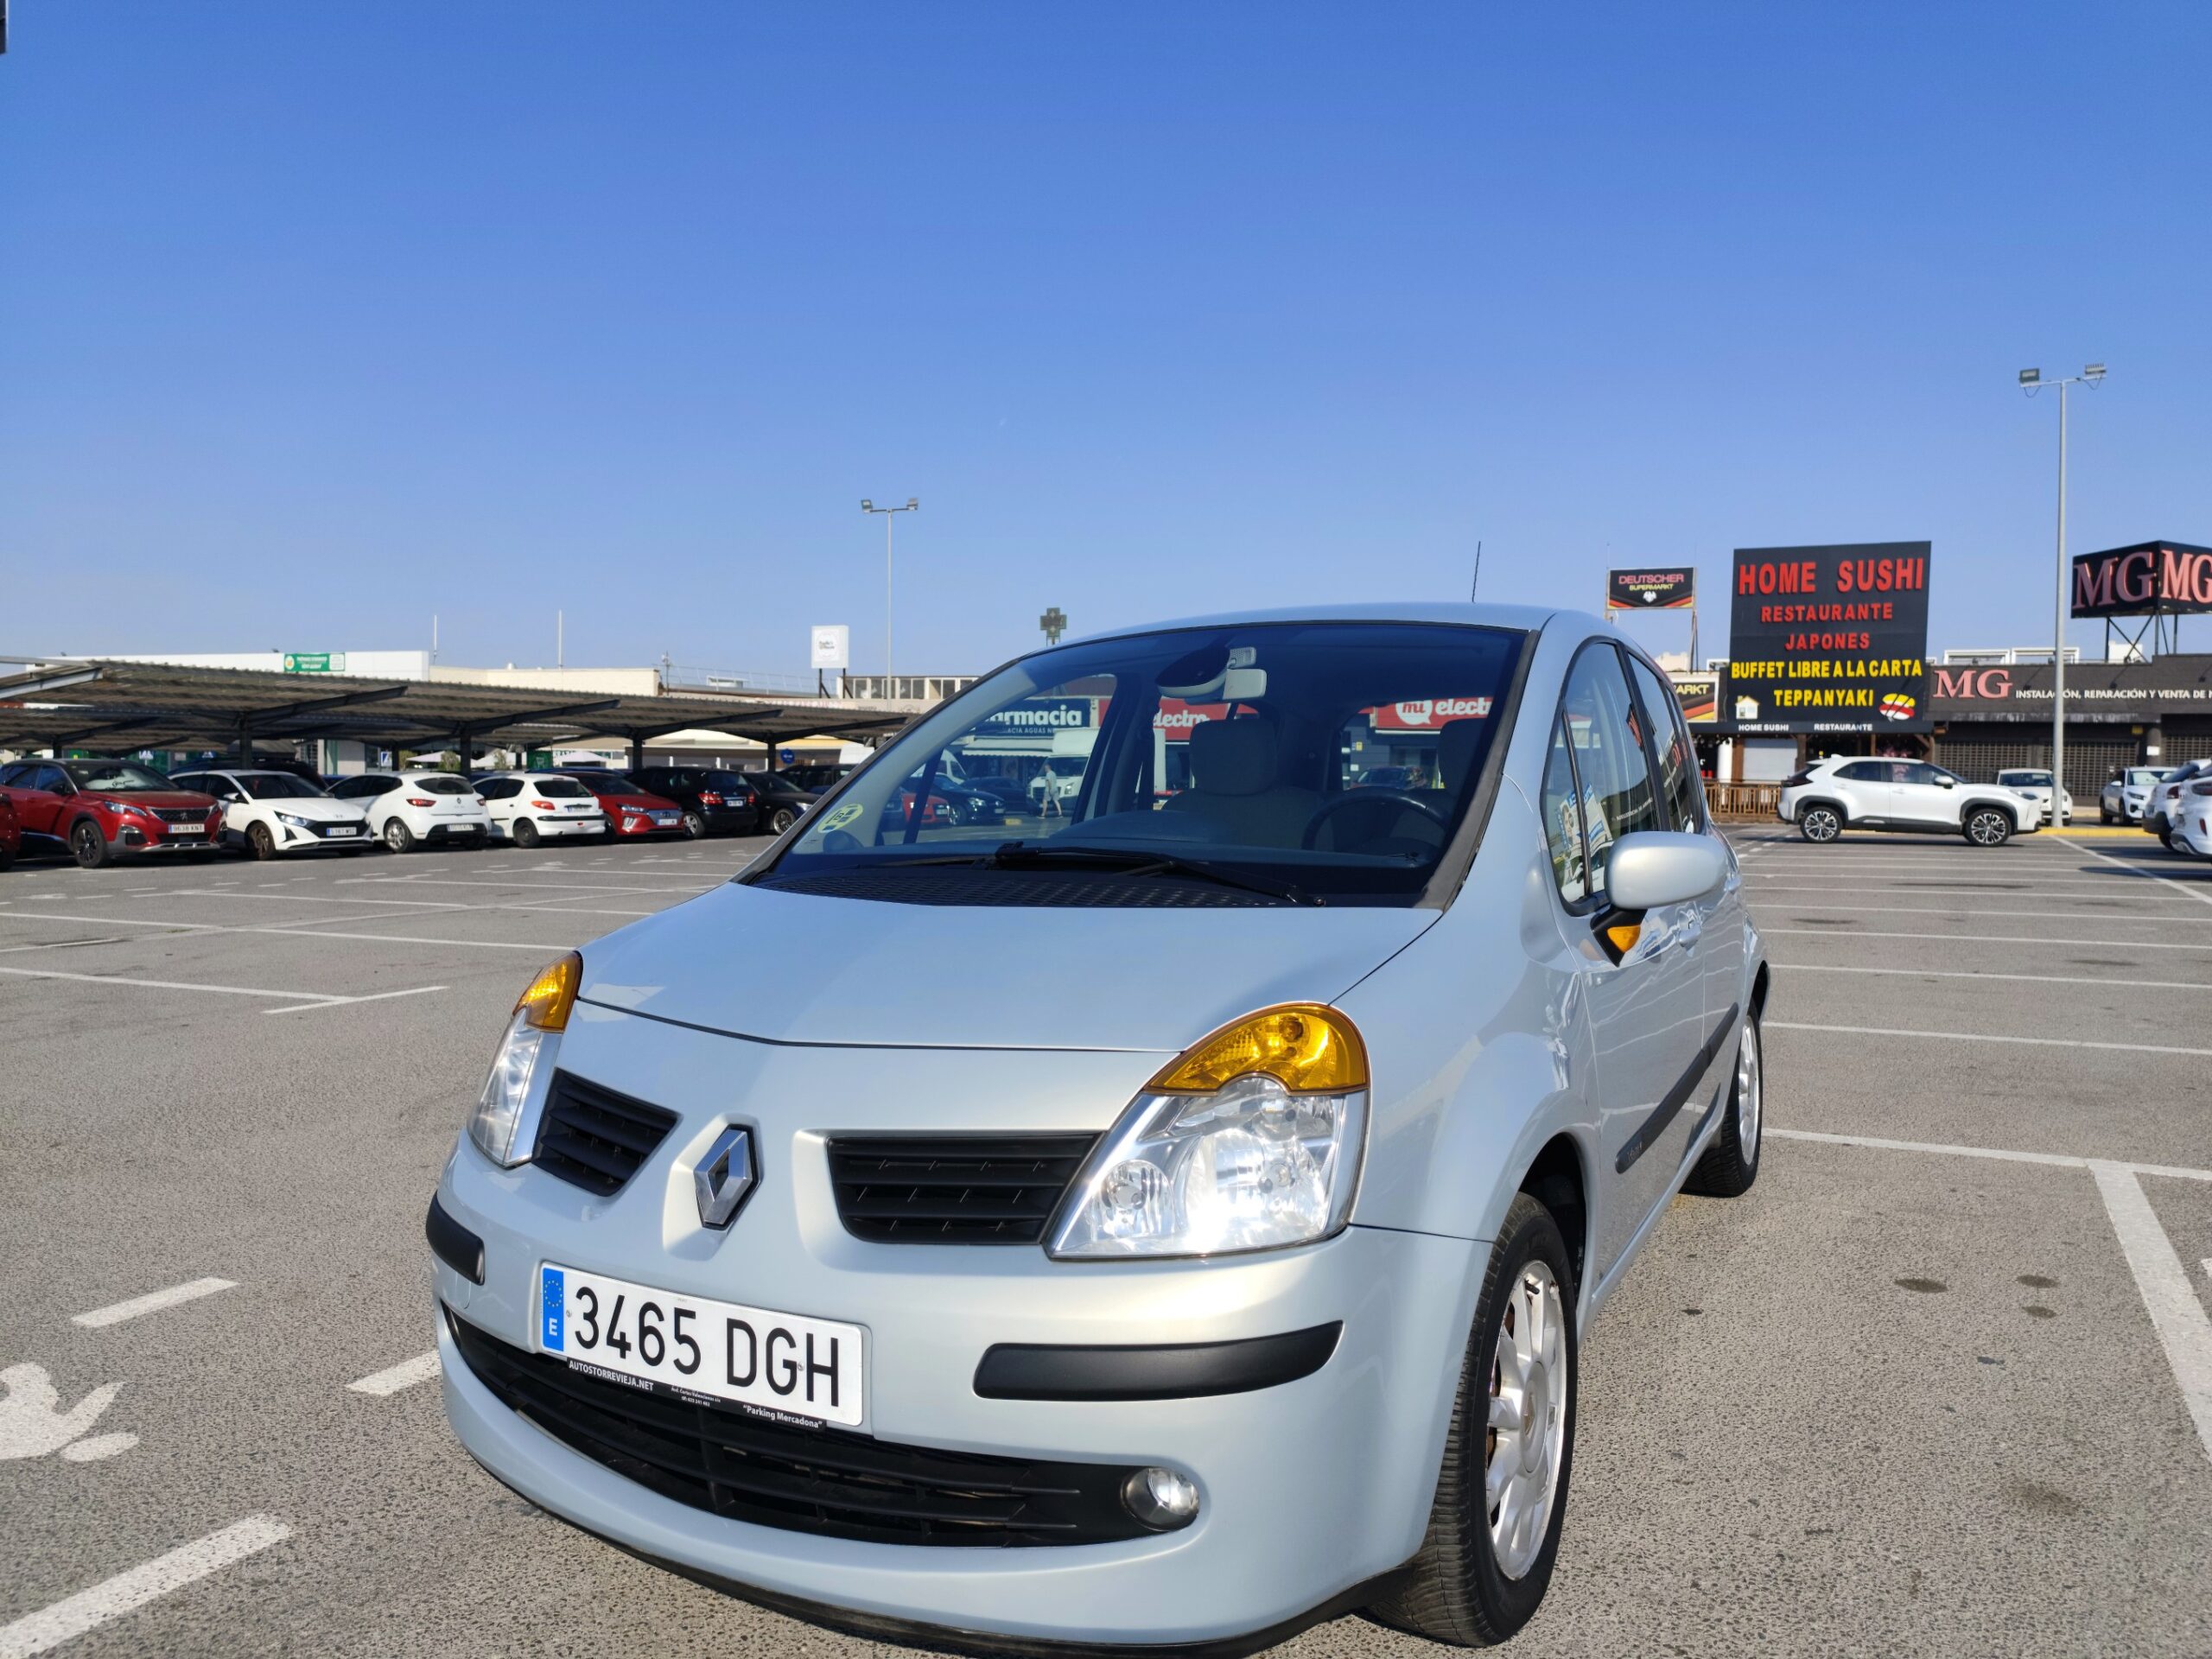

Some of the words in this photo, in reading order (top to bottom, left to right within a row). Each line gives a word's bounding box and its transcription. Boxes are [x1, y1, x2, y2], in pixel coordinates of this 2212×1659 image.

[1618, 573, 1684, 584] DEUTSCHER
[1738, 562, 1816, 594] HOME
[1837, 557, 1923, 592] SUSHI
[2072, 551, 2158, 608] MG
[2161, 550, 2212, 603] MG
[1761, 603, 1893, 622] RESTAURANTE
[1785, 632, 1870, 650] JAPONES
[1731, 660, 1784, 678] BUFFET
[1789, 660, 1829, 677] LIBRE
[1833, 660, 1843, 677] A
[1847, 660, 1866, 677] LA
[1869, 659, 1923, 677] CARTA
[1673, 683, 1710, 695] ARKT
[1932, 668, 2014, 699] MG
[1774, 689, 1873, 707] TEPPANYAKI
[2015, 688, 2082, 699] INSTALAÓN,
[2084, 688, 2146, 699] REPARACIÓN
[2149, 690, 2156, 699] Y
[2158, 690, 2190, 699] VENTA
[2193, 690, 2205, 699] DE
[985, 704, 1082, 726] armacia
[1738, 723, 1763, 732] HOME
[1764, 723, 1789, 732] SUSHI
[1814, 722, 1873, 732] RESTAURANTE
[549, 1317, 558, 1337] E
[575, 1287, 701, 1375] 3465
[727, 1319, 839, 1407] DGH
[569, 1360, 654, 1391] AUTOSTORREVIEJA.NET
